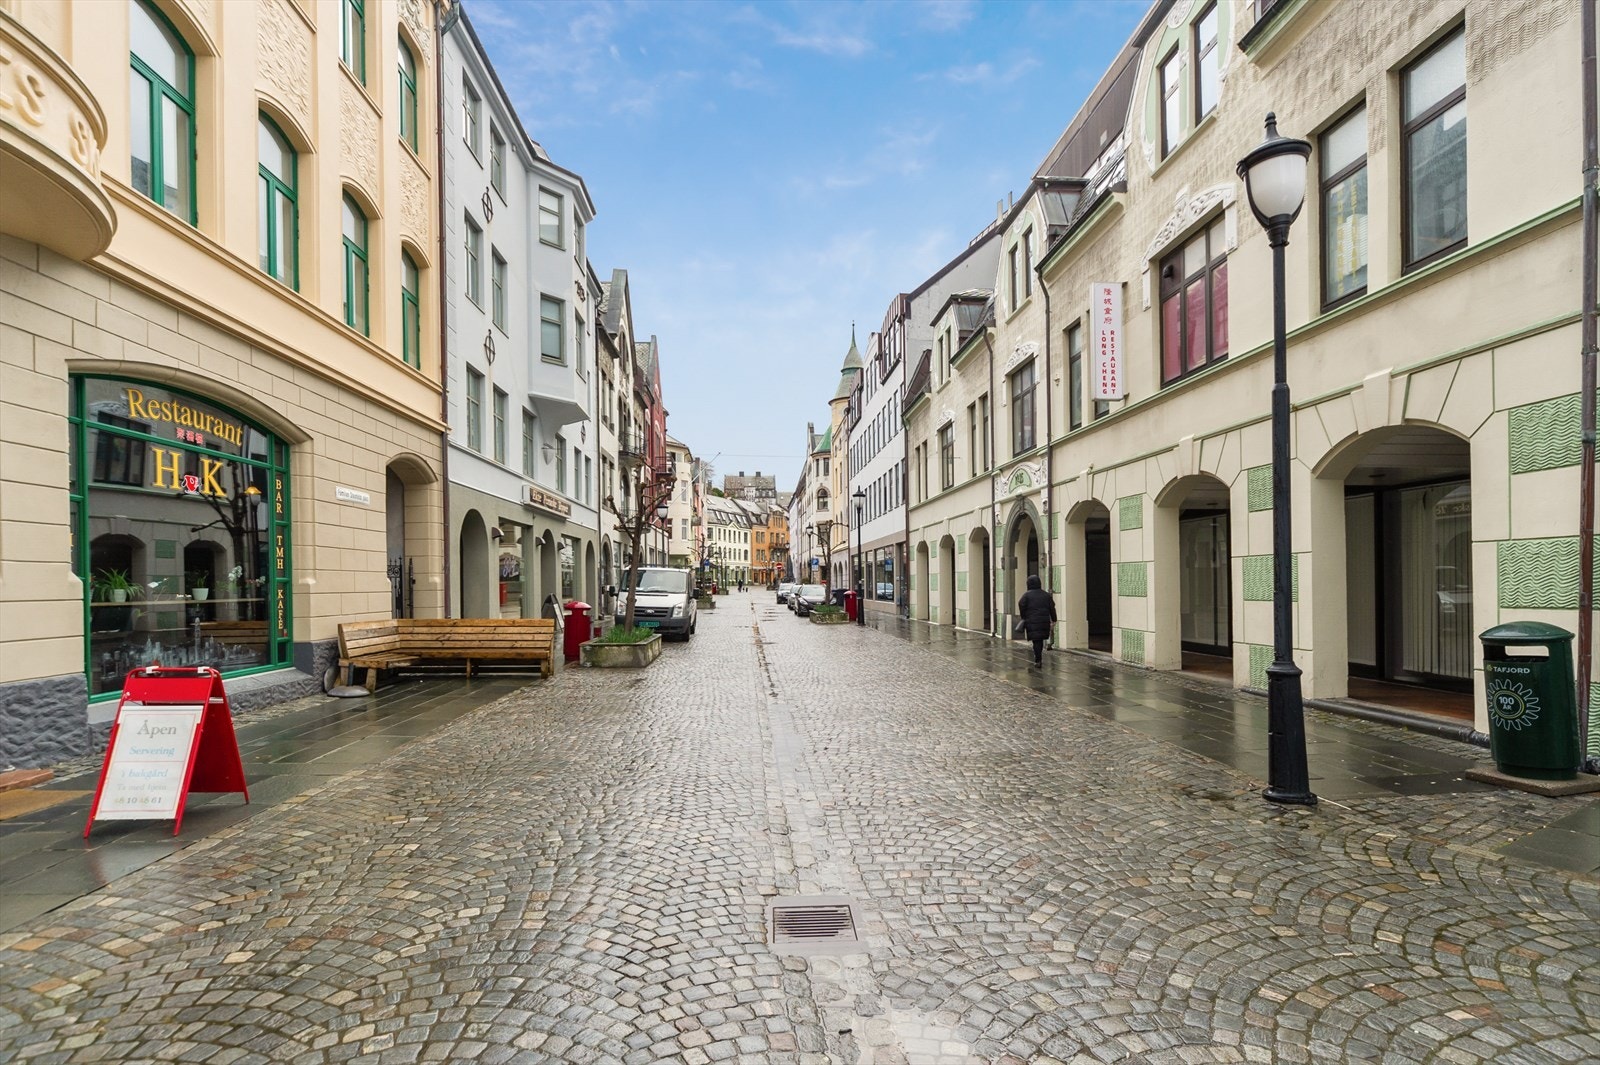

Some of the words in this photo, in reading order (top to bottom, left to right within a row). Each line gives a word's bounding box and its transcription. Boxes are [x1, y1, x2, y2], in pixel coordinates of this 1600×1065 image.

[126, 388, 243, 446] Restaurant
[151, 447, 182, 490] H
[200, 458, 227, 497] K
[276, 535, 284, 569] TMH
[1493, 666, 1531, 674] TAFJORD
[1498, 696, 1515, 705] 100
[136, 719, 177, 739] Åpen
[129, 745, 175, 758] Servering
[127, 796, 138, 804] 10
[151, 796, 162, 804] 61
